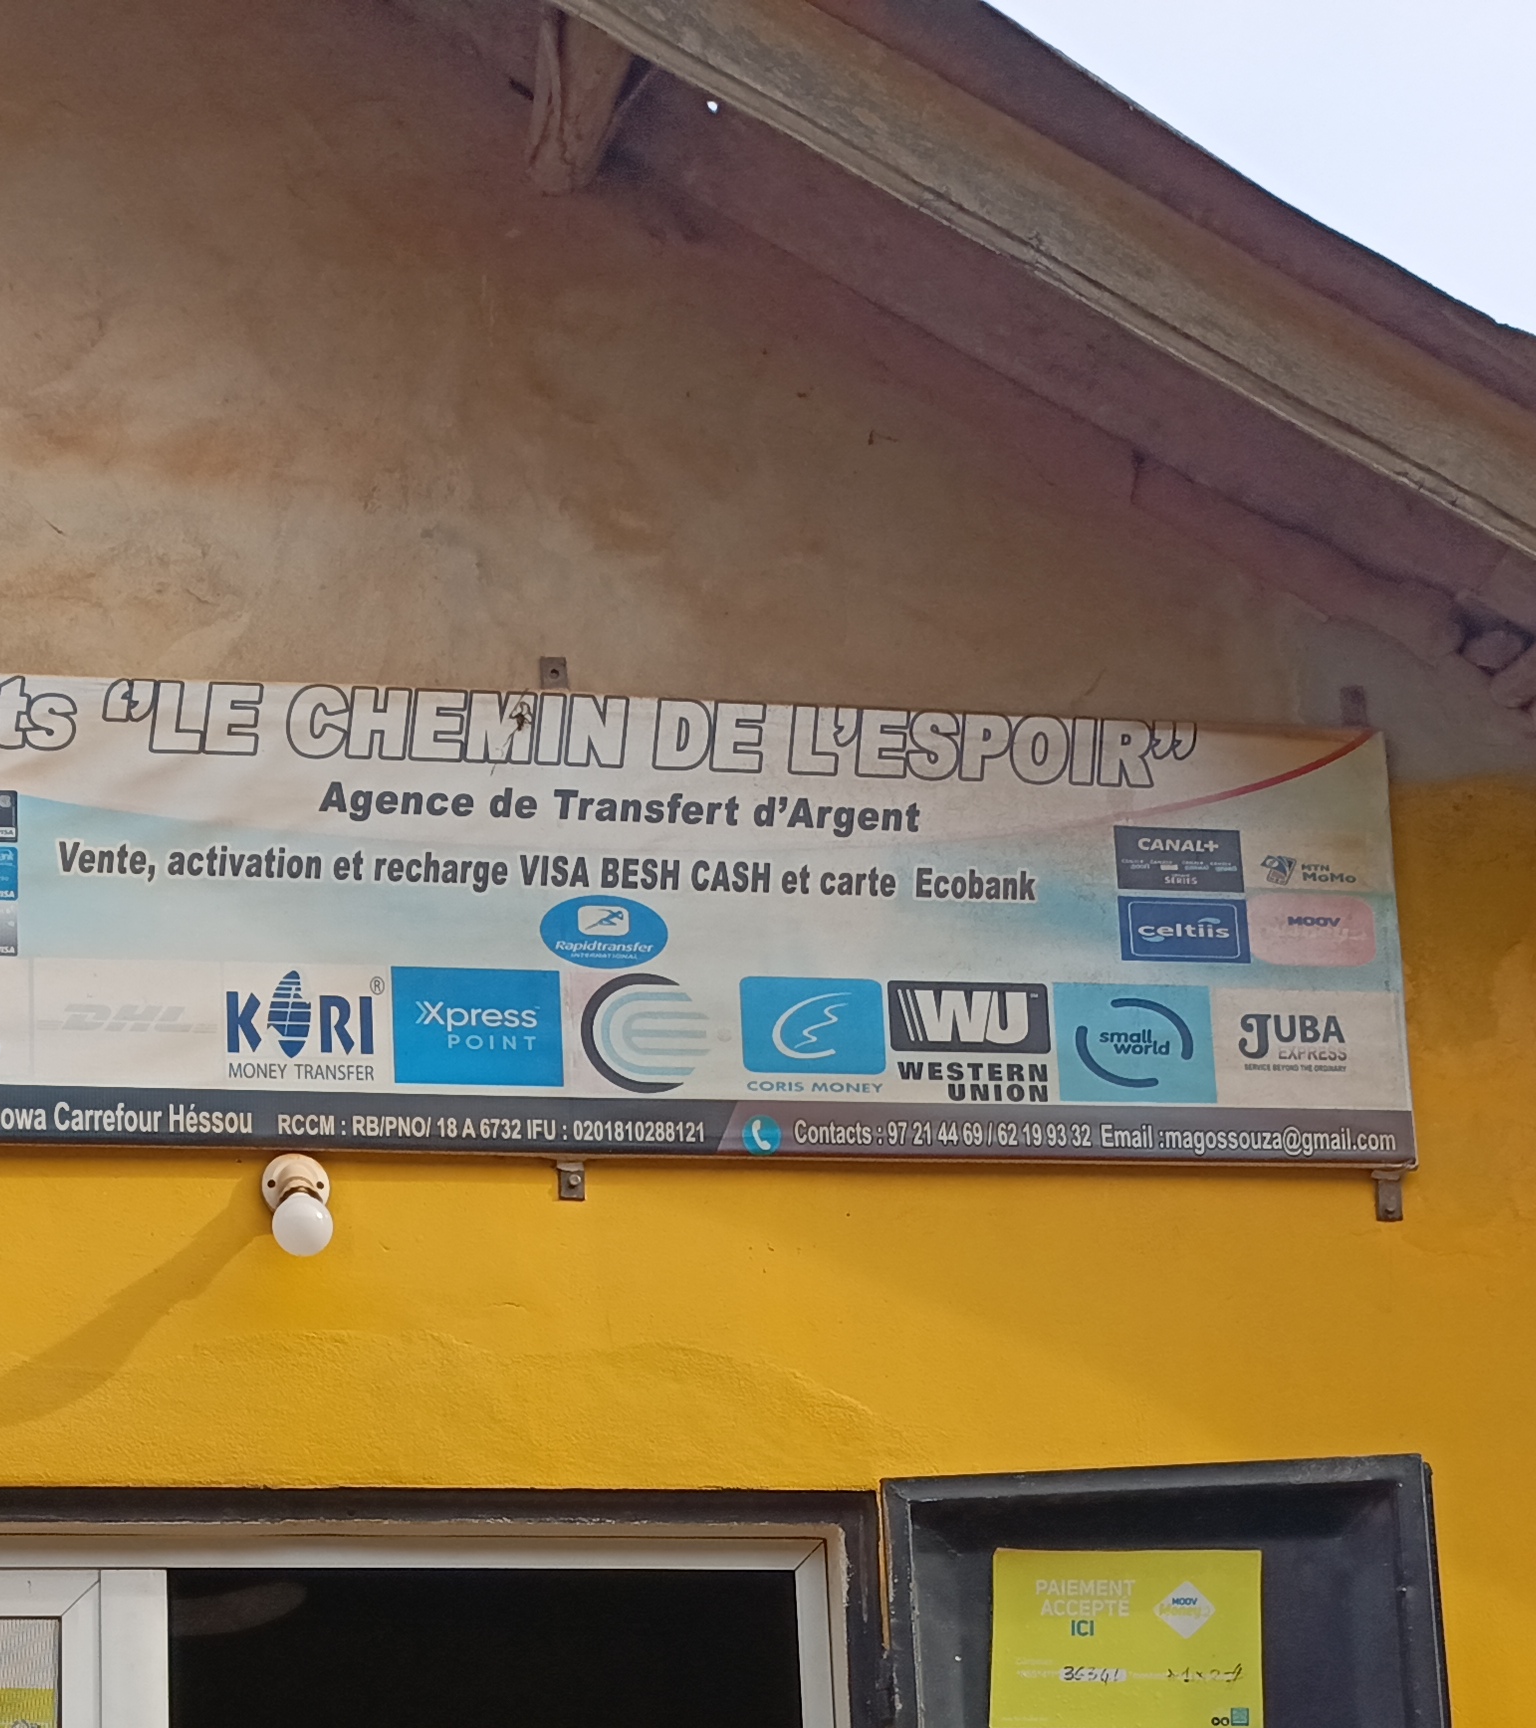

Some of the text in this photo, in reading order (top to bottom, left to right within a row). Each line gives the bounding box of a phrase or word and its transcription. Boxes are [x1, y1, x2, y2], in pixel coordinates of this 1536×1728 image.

[286, 684, 629, 768] CHEMIN
[652, 697, 766, 774] DE
[319, 781, 474, 821] Agence
[489, 788, 537, 819] de
[554, 789, 739, 826] Transfert
[1138, 838, 1219, 852] CANAL+
[58, 841, 1037, 901] Vente, activation et recharge VISA BESH CASH et carte Ecobank
[1301, 864, 1330, 872] MTN
[1302, 872, 1357, 884] MoMo
[1138, 917, 1230, 940] celtiis
[1287, 916, 1341, 927] MOOV
[555, 940, 654, 955] Rapidtransfer
[63, 1004, 186, 1033] DHL
[421, 1001, 538, 1031] Xpress
[911, 988, 1030, 1045] WU
[448, 1035, 537, 1051] POINT
[1099, 1029, 1152, 1044] small
[1238, 1013, 1345, 1059] JUBA
[1114, 1040, 1170, 1056] world
[1278, 1047, 1347, 1061] EXPRESS
[228, 1062, 374, 1081] MONEY TRANSFER
[897, 1061, 1049, 1082] WESTERN
[747, 1081, 883, 1094] CORIS MONEY
[947, 1083, 1050, 1102] UNION
[54, 1102, 162, 1133] Carrefour
[168, 1103, 253, 1134] Héssou
[277, 1114, 335, 1136] RCCM
[437, 1117, 458, 1138] 18
[462, 1119, 477, 1138] A
[479, 1119, 522, 1140] 6732
[526, 1119, 557, 1141] IFU
[572, 1120, 705, 1143] 0201810288121
[794, 1119, 872, 1146] Contacts
[887, 1121, 907, 1146] 97
[913, 1122, 932, 1146] 21
[937, 1122, 958, 1146] 44
[963, 1122, 982, 1146] 69
[997, 1122, 1017, 1147] 62
[1022, 1122, 1042, 1147] 19
[1047, 1123, 1067, 1148] 93
[1071, 1124, 1092, 1148] 32
[1100, 1124, 1154, 1150] Email
[1035, 1579, 1136, 1597] PAIEMENT
[1040, 1596, 1131, 1618] ACCEPTÉ
[1172, 1597, 1197, 1606] MOOV
[1071, 1620, 1094, 1637] ICI
